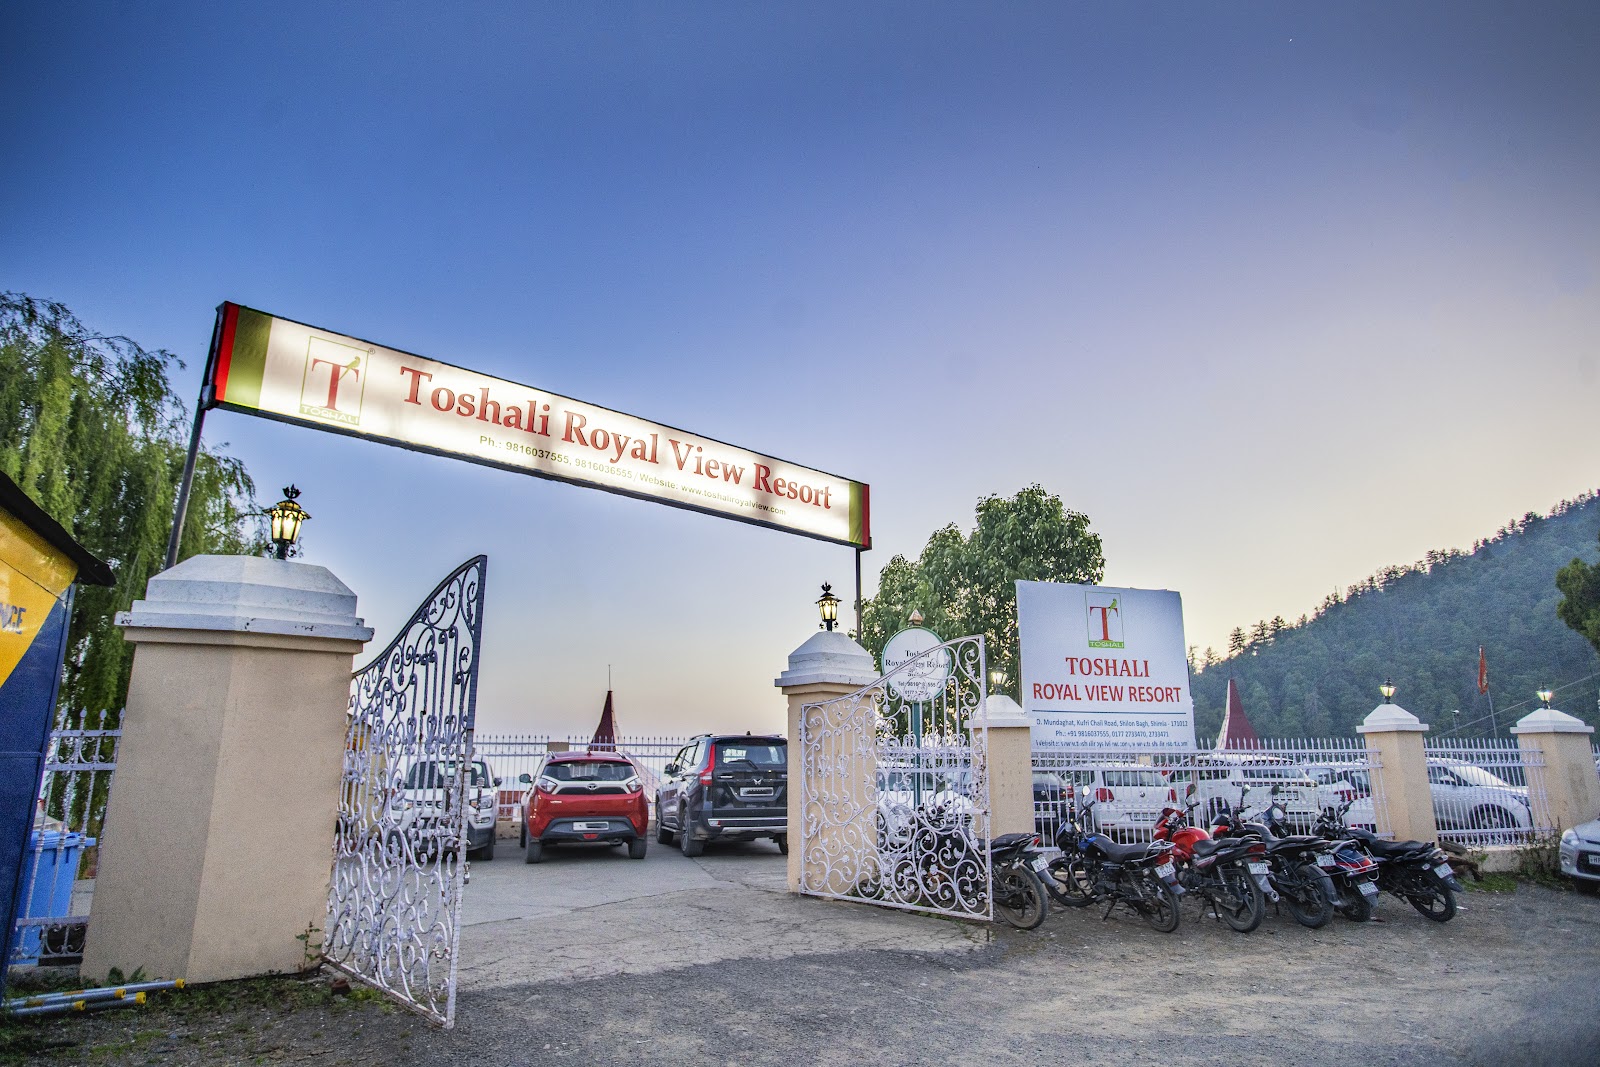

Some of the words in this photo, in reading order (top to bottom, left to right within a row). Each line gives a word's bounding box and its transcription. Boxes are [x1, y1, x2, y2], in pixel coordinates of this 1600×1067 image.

[301, 406, 360, 425] TOSHALI
[400, 366, 551, 437] Toshali
[561, 410, 660, 465] Royal
[668, 438, 746, 486] View
[752, 462, 833, 510] Resort
[505, 441, 572, 466] 9816037555,
[639, 472, 679, 490] Website:
[681, 484, 787, 516] www.toshaliroyalview.com
[1090, 641, 1125, 649] TOSHALI
[1065, 657, 1150, 678] TOSHALI
[1033, 683, 1082, 701] ROYAL
[1085, 684, 1124, 702] VIEW
[1129, 686, 1182, 703] RESORT
